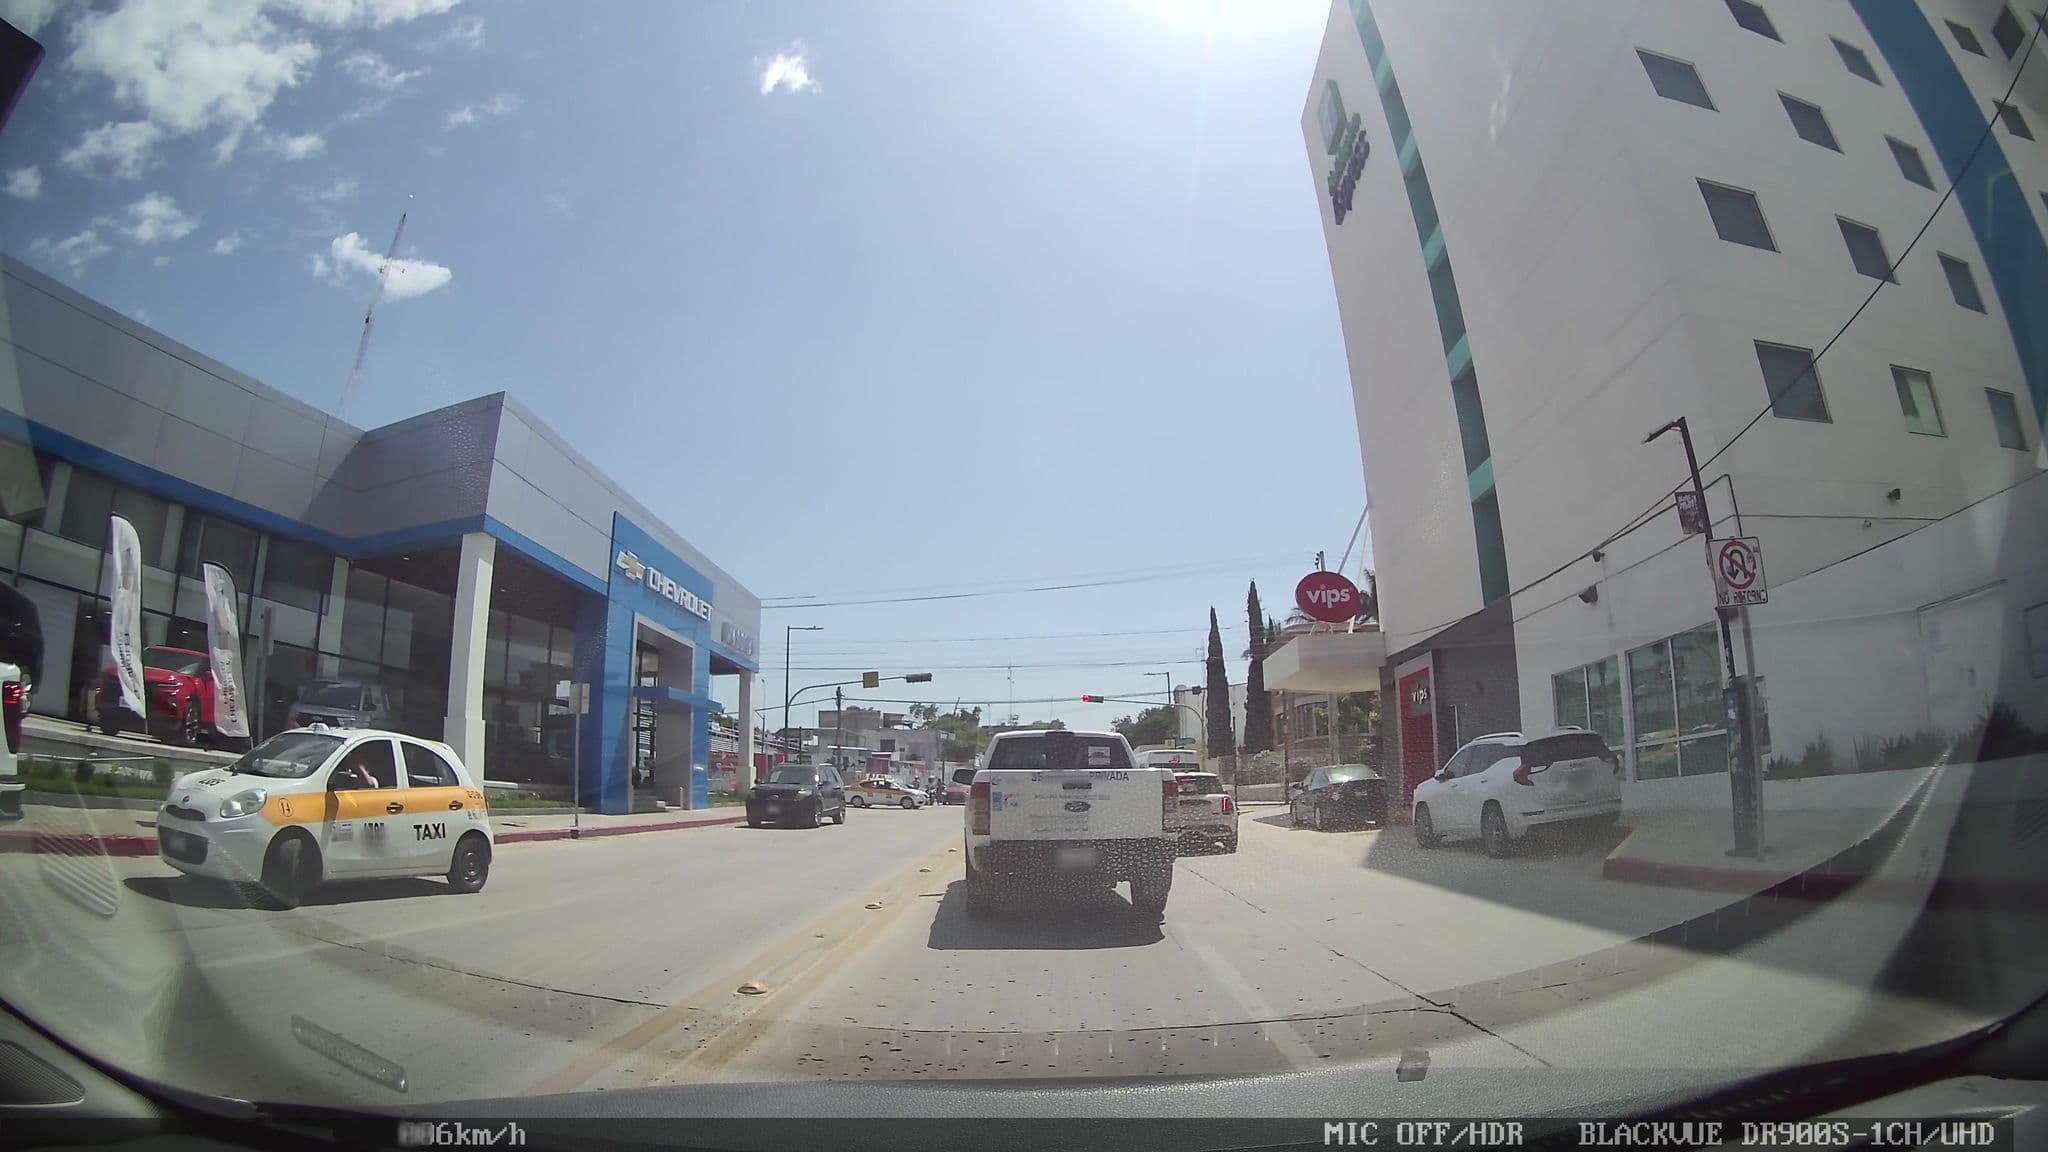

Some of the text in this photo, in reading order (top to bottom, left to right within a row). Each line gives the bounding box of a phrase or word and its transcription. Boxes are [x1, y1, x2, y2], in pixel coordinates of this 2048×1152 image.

[647, 566, 715, 622] CHEVROLET
[1306, 584, 1351, 609] vips
[1719, 591, 1730, 605] NO
[1412, 684, 1428, 705] vips
[413, 822, 446, 841] TAXI
